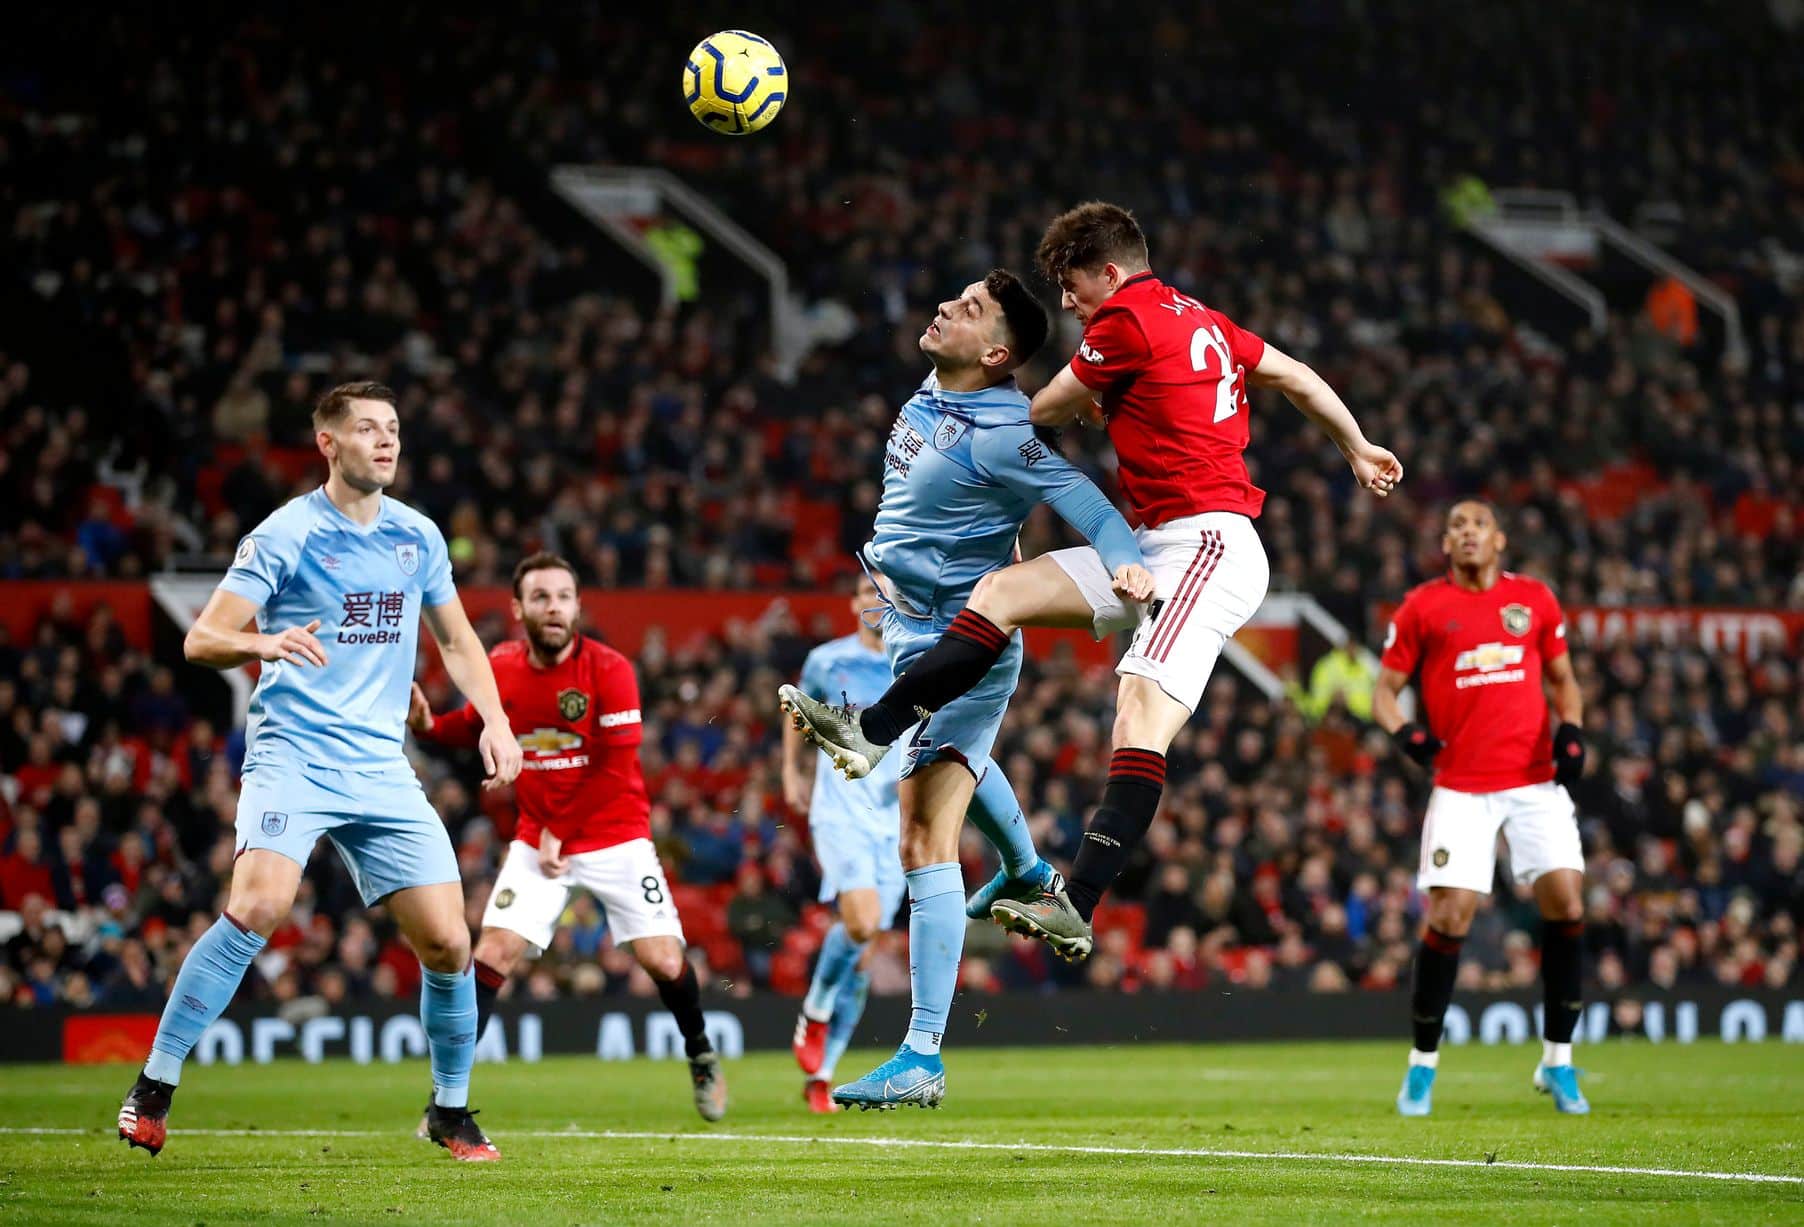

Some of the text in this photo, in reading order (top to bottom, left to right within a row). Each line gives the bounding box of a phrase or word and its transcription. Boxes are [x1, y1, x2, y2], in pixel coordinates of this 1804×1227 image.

[340, 591, 405, 628] 爱博
[337, 630, 402, 645] LoveBet
[641, 875, 663, 904] 8
